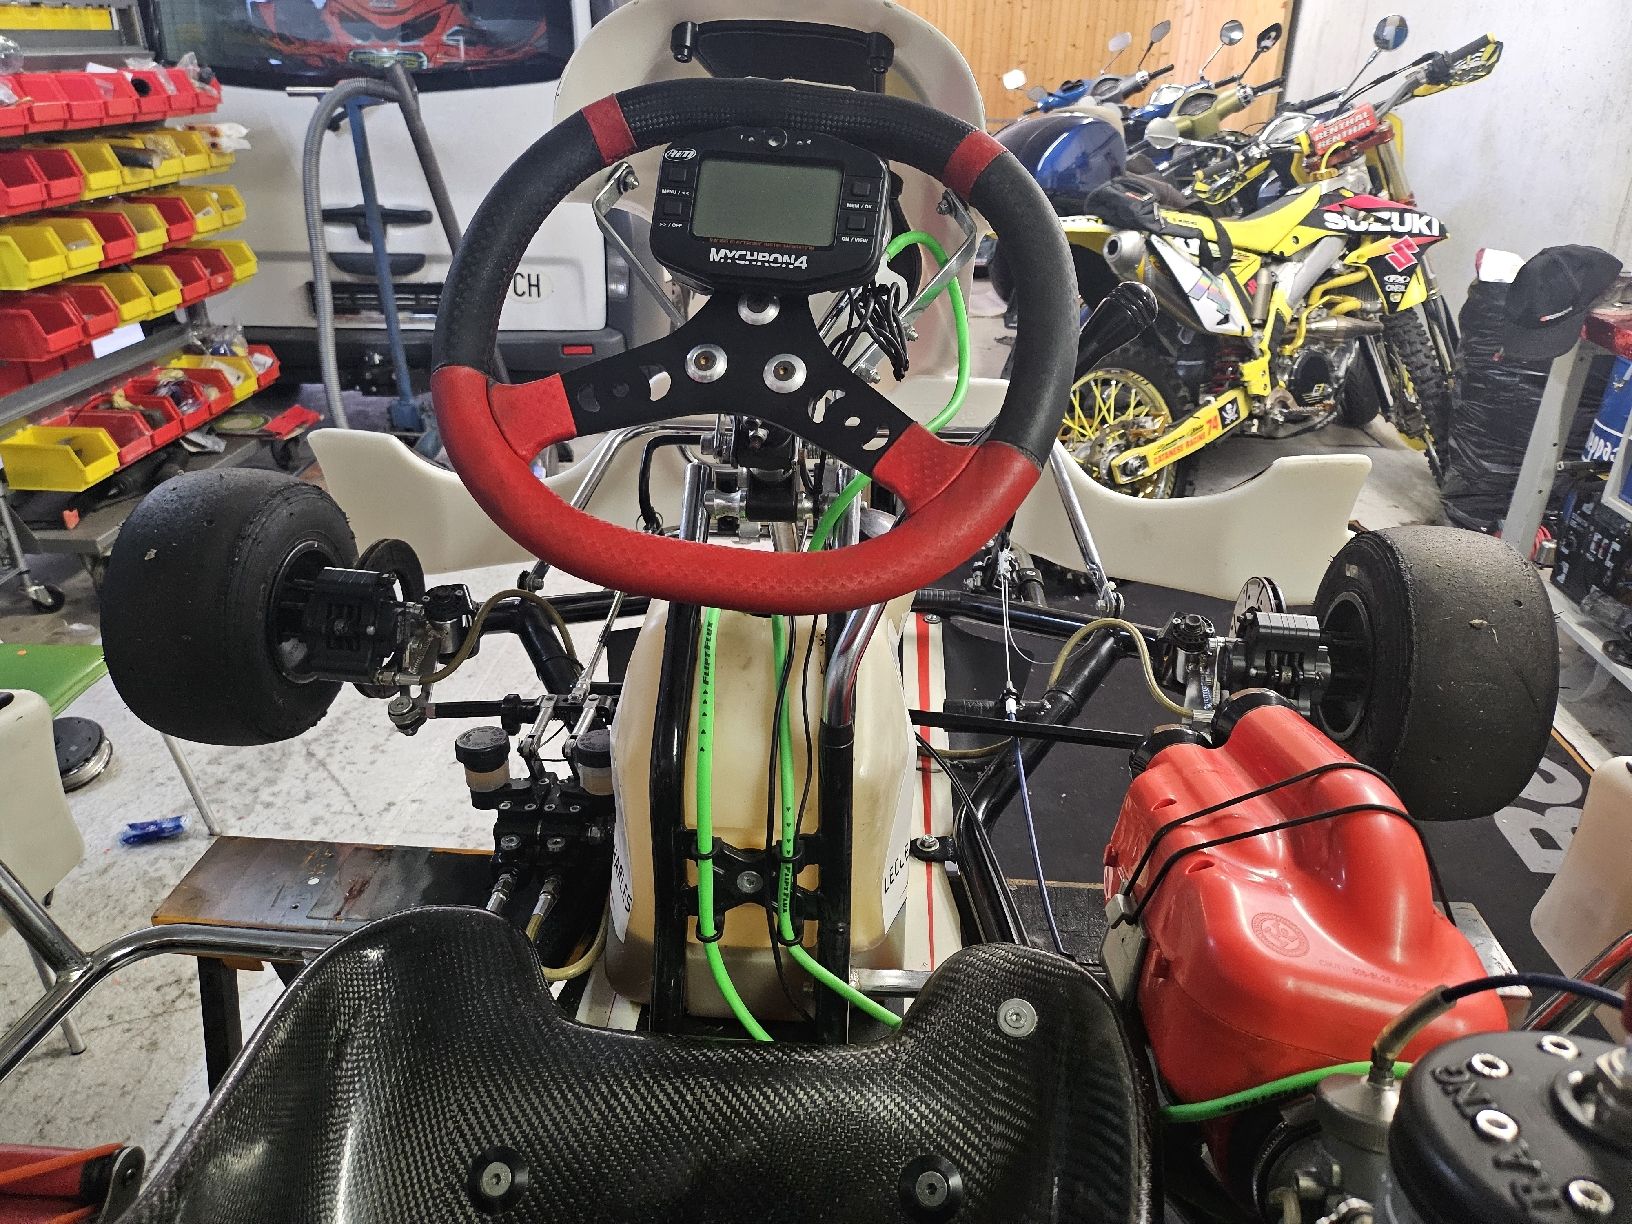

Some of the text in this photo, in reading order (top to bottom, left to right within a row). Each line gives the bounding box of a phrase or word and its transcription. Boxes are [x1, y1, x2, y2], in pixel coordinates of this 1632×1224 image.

[1314, 111, 1370, 141] RENTHAL
[1323, 211, 1440, 237] SUZUKI
[709, 247, 808, 270] MYCHRON4
[513, 272, 542, 298] CH
[1206, 415, 1220, 436] 74
